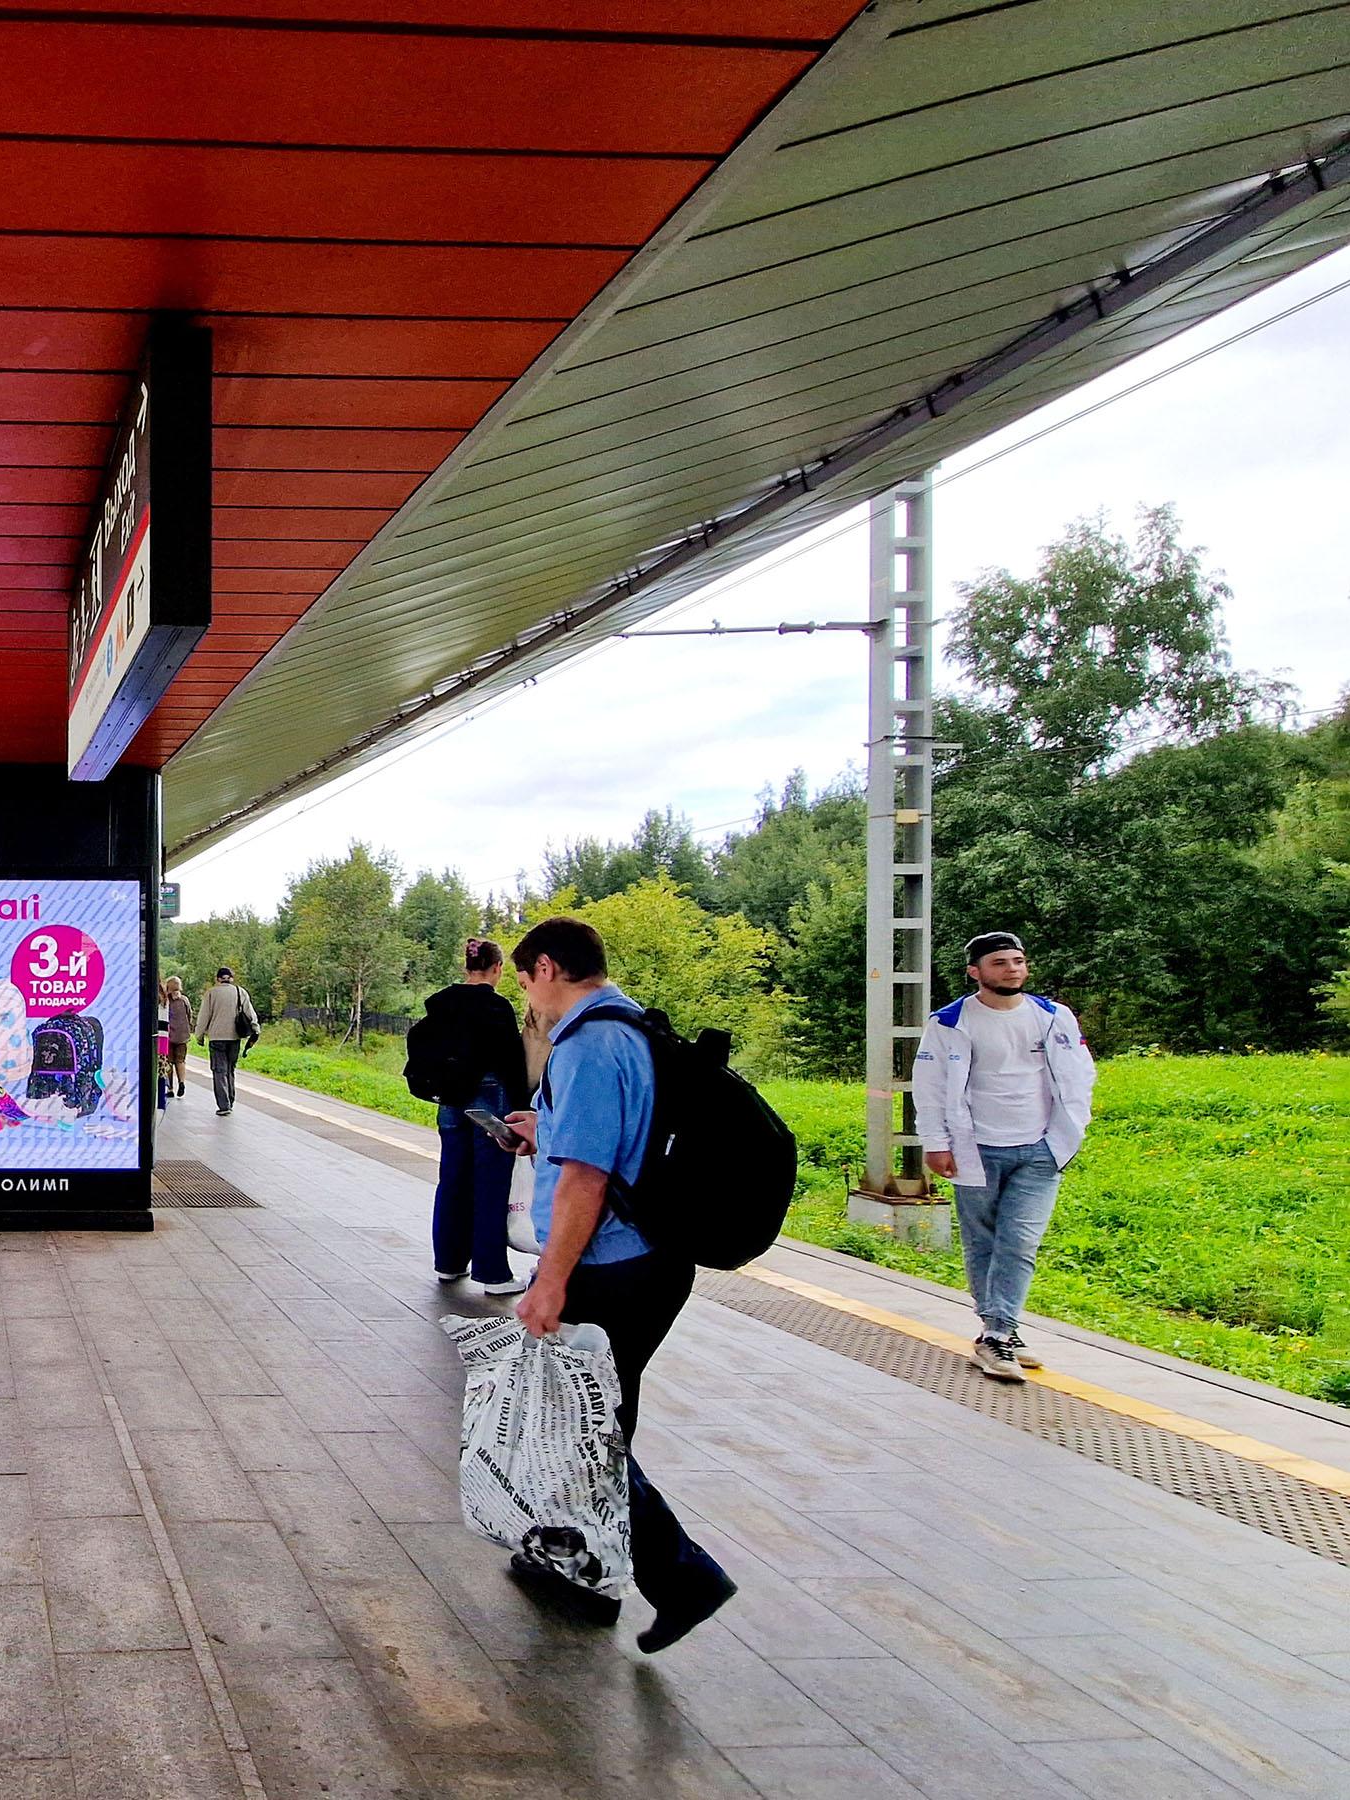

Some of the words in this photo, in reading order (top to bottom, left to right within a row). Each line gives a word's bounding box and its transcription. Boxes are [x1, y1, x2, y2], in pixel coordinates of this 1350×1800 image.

[105, 428, 136, 548] Выход
[121, 489, 135, 556] Exit
[29, 980, 87, 994] ТОВАР
[29, 997, 36, 1006] В
[38, 997, 87, 1007] ПОДАРОК
[1, 1178, 69, 1191] ОЛИМП
[580, 1372, 606, 1416] READY
